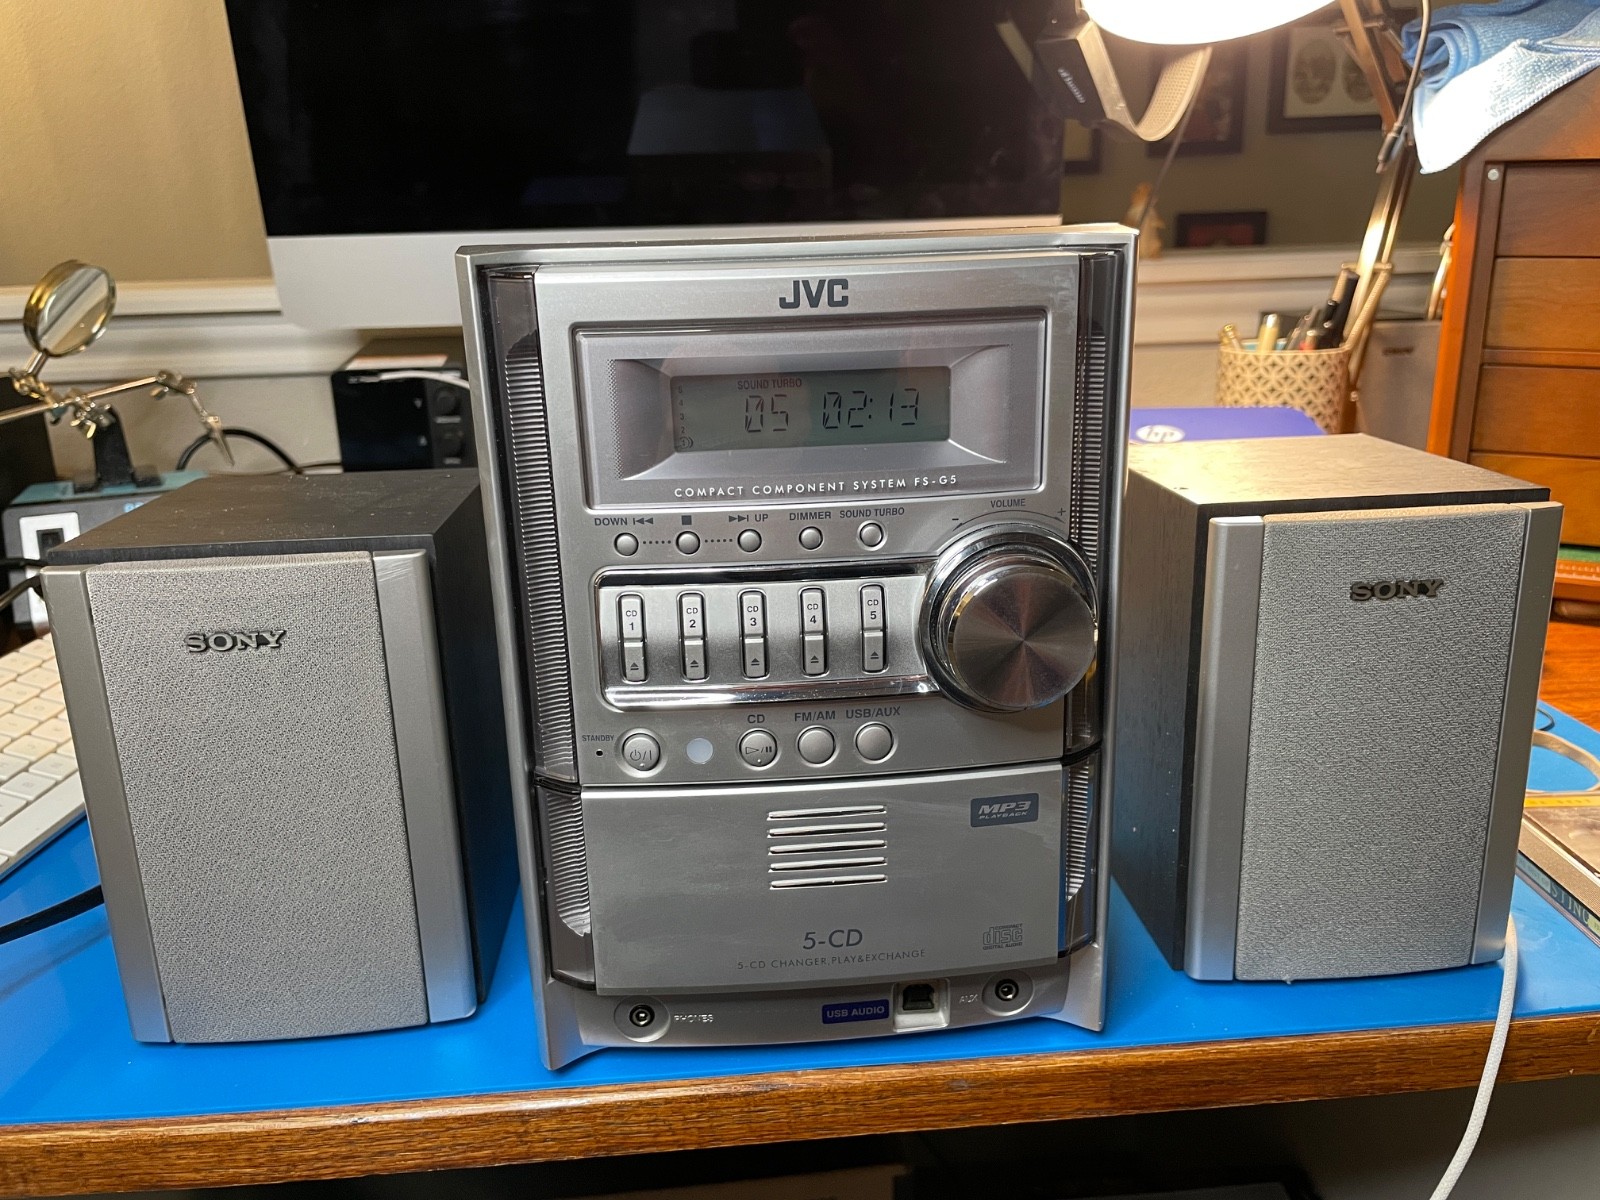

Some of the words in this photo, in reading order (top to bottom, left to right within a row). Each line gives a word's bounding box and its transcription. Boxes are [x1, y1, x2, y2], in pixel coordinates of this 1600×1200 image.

[779, 278, 849, 309] JVC
[737, 379, 769, 391] SOUND
[772, 377, 803, 389] TURBO
[744, 393, 789, 433] 05
[822, 387, 920, 430] 02:13
[680, 425, 686, 434] 2
[674, 485, 744, 498] COMPACT
[751, 481, 845, 496] COMPONENT
[852, 478, 907, 491] SYSTEM
[913, 474, 958, 488] FS-G5
[990, 498, 1027, 509] VOLUME
[754, 513, 769, 523] UP
[789, 511, 832, 522] DIMMER
[839, 508, 872, 519] SOUND
[873, 506, 905, 517] TURBO
[594, 517, 628, 527] DOWN
[1350, 578, 1445, 602] SONY
[806, 603, 820, 612] CD
[866, 599, 880, 607] CD
[625, 610, 639, 618] CD
[685, 607, 700, 616] CD
[746, 605, 760, 614] CD
[809, 615, 818, 625] 4
[869, 610, 878, 621] 5
[629, 622, 635, 631] 1
[688, 619, 697, 629] 2
[749, 617, 758, 627] 3
[183, 629, 287, 654] SONY
[747, 713, 766, 724] CD
[794, 710, 837, 722] FM/AM
[845, 706, 902, 720] USB/AUX
[581, 733, 615, 743] STANDBY
[978, 800, 1032, 815] MP3
[979, 811, 1028, 820] PLAYBACK
[802, 928, 864, 950] 5-CD
[737, 960, 766, 970] 5-CD
[826, 1008, 849, 1019] USB
[851, 1005, 885, 1017] AUDIO
